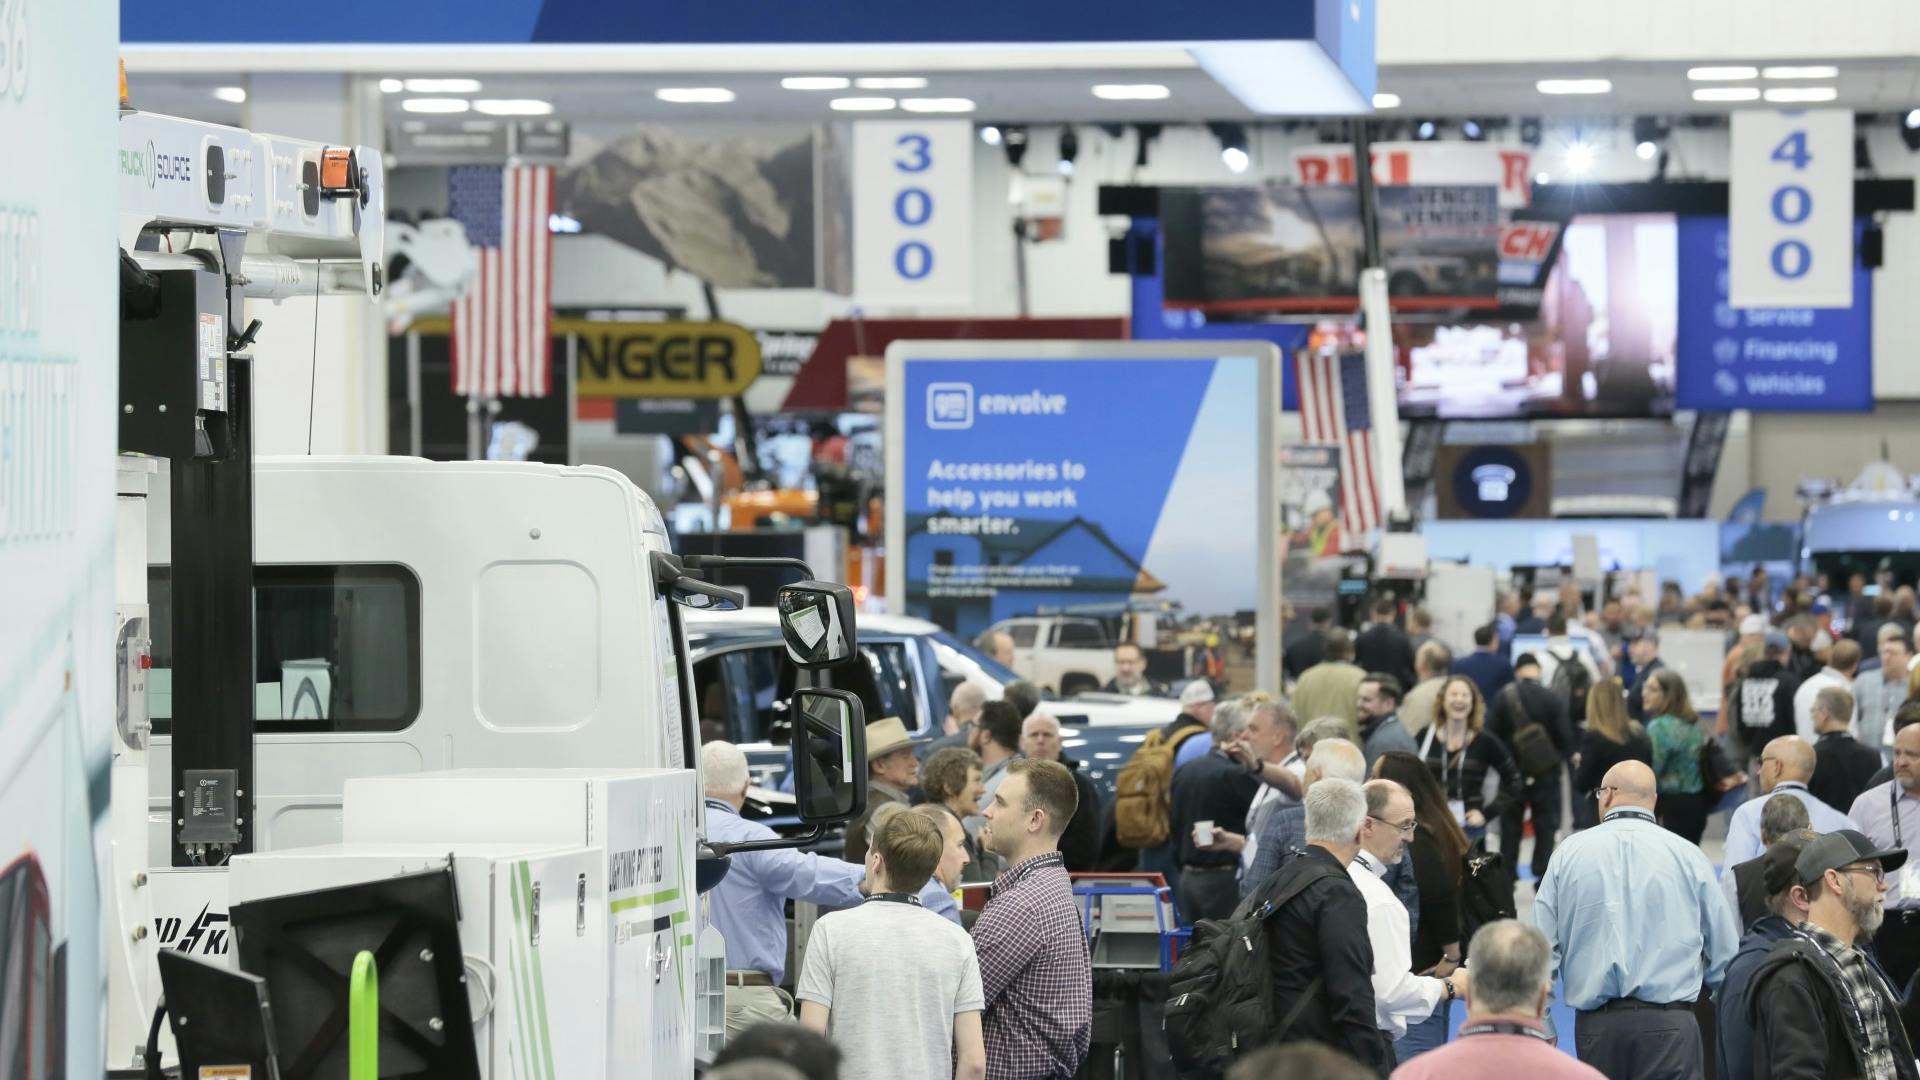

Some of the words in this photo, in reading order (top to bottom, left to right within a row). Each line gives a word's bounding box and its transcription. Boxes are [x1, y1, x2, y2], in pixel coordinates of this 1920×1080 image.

[157, 154, 191, 182] SOURCE
[894, 133, 934, 281] 300
[1770, 129, 1813, 280] 400
[1744, 338, 1838, 365] Financing
[1745, 374, 1826, 396] Vehicles
[979, 389, 1067, 415] envolve
[927, 459, 1058, 480] Accessories
[1062, 460, 1086, 480] to
[927, 486, 975, 511] help
[979, 491, 1020, 512] you
[1024, 486, 1077, 508] work
[927, 513, 1020, 535] smarter.
